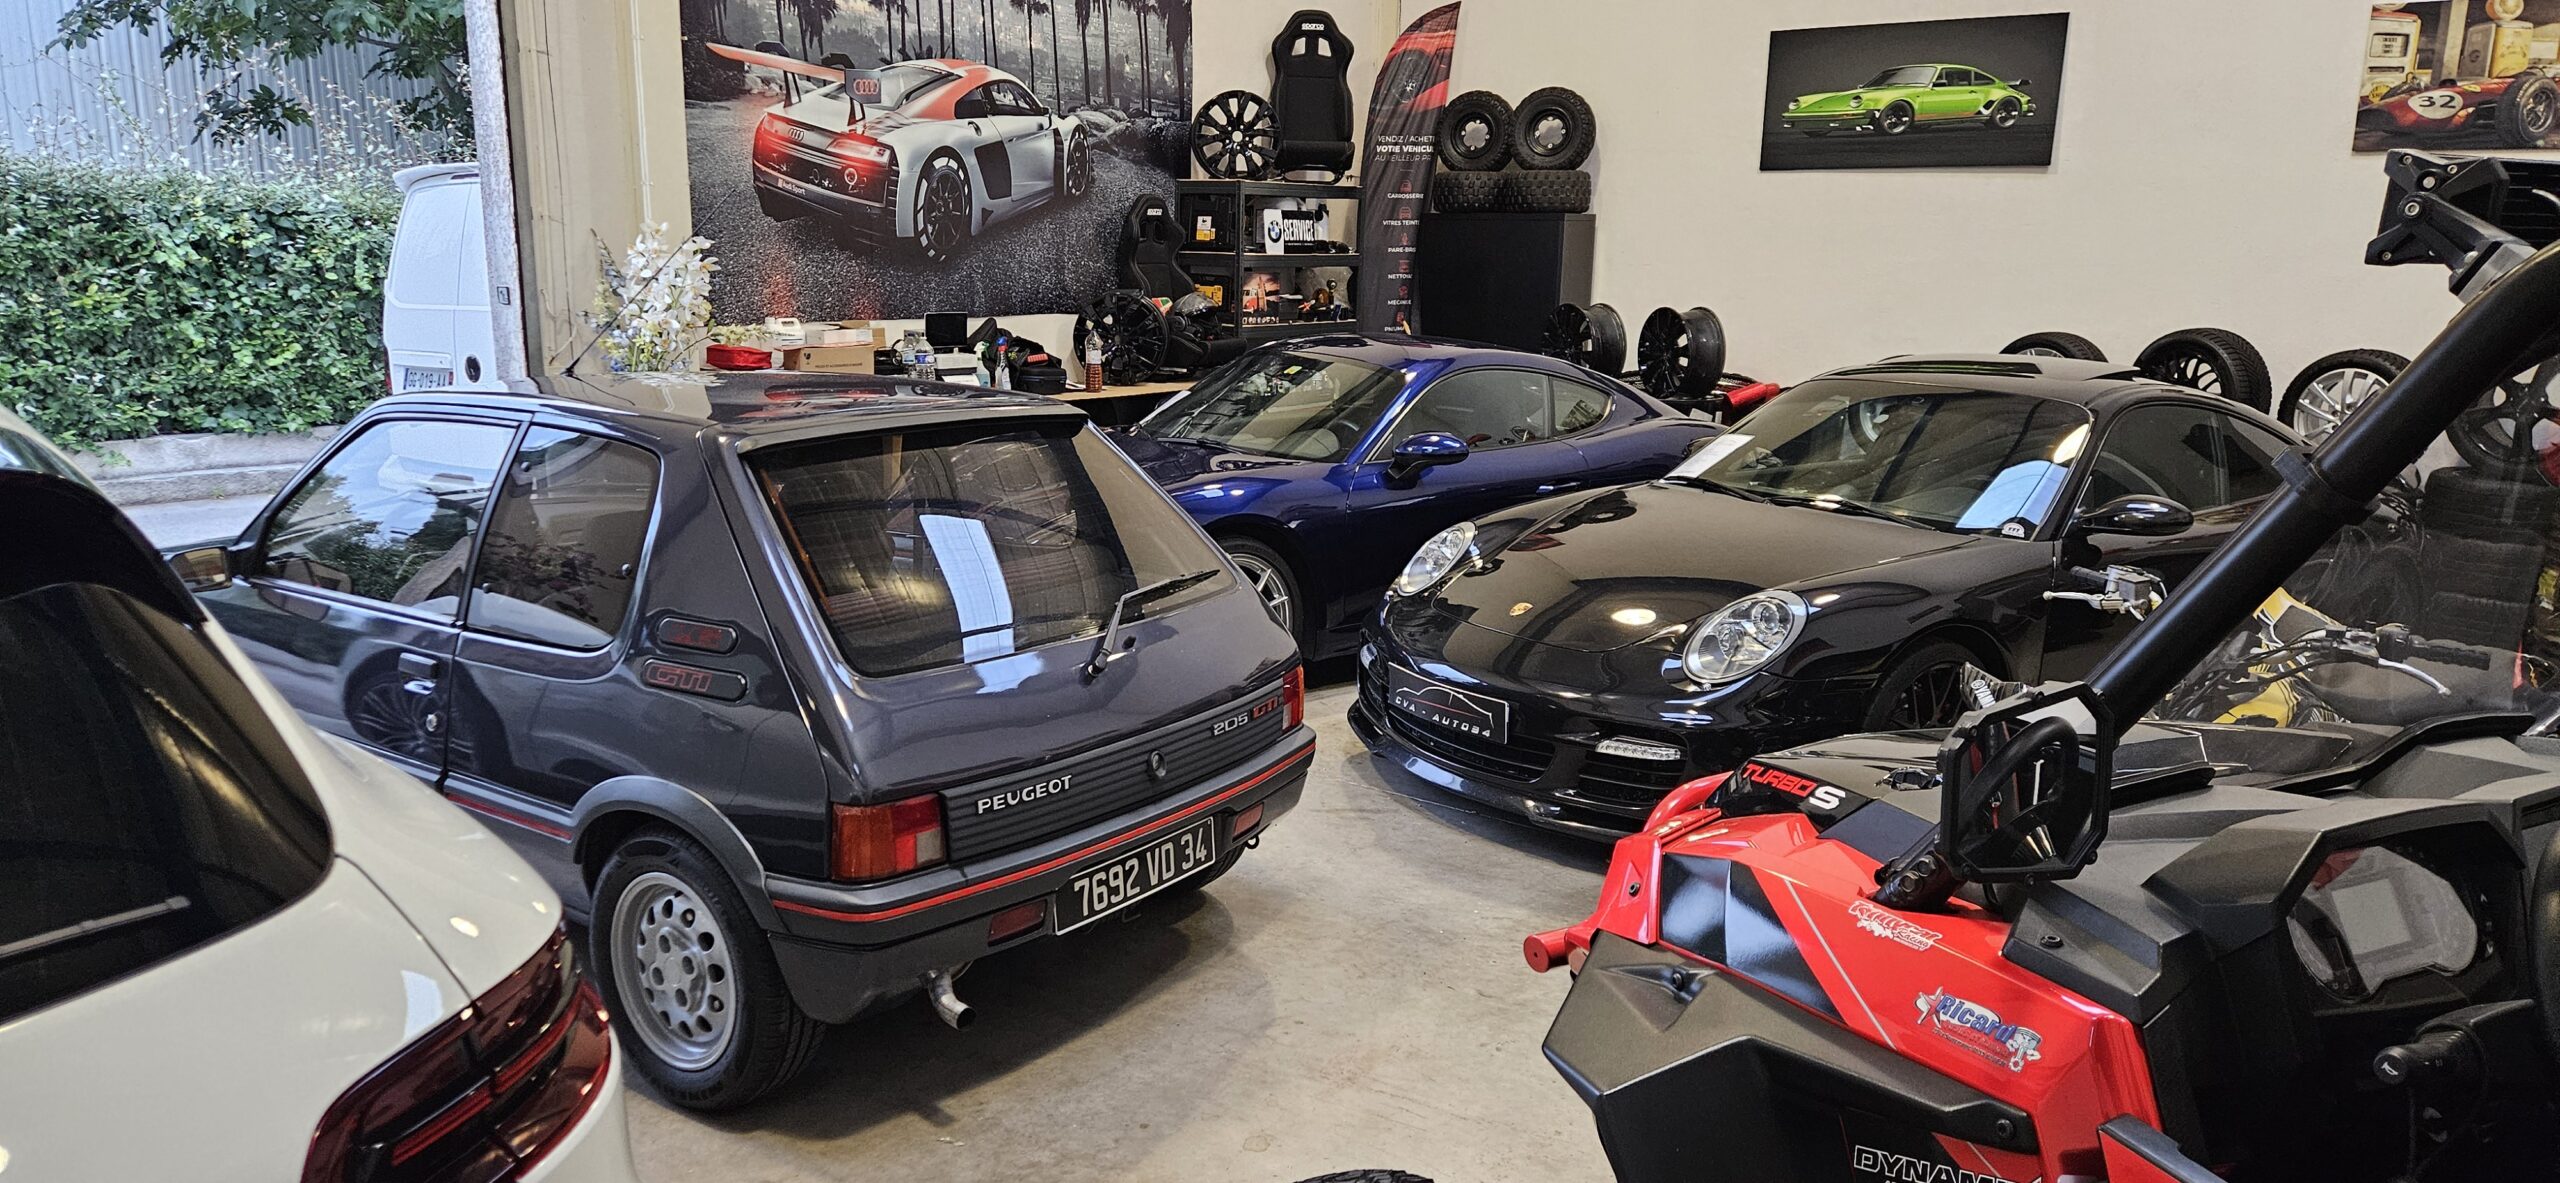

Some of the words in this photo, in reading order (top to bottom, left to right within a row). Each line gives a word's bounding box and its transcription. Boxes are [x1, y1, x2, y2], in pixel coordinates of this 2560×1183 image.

[2418, 94, 2456, 109] 32
[1283, 218, 1315, 242] SERVICE
[645, 664, 713, 693] GTI
[1213, 712, 1249, 736] 205
[1253, 696, 1279, 719] GTI
[1395, 696, 1416, 713] CVA
[977, 774, 1073, 815] PEUGEOT
[1742, 762, 1818, 798] TURBO
[1808, 785, 1846, 810] S
[1073, 857, 1141, 917] 7692
[1146, 841, 1176, 887] VD
[1180, 827, 1208, 871] 34
[1936, 993, 2018, 1045] Ricard
